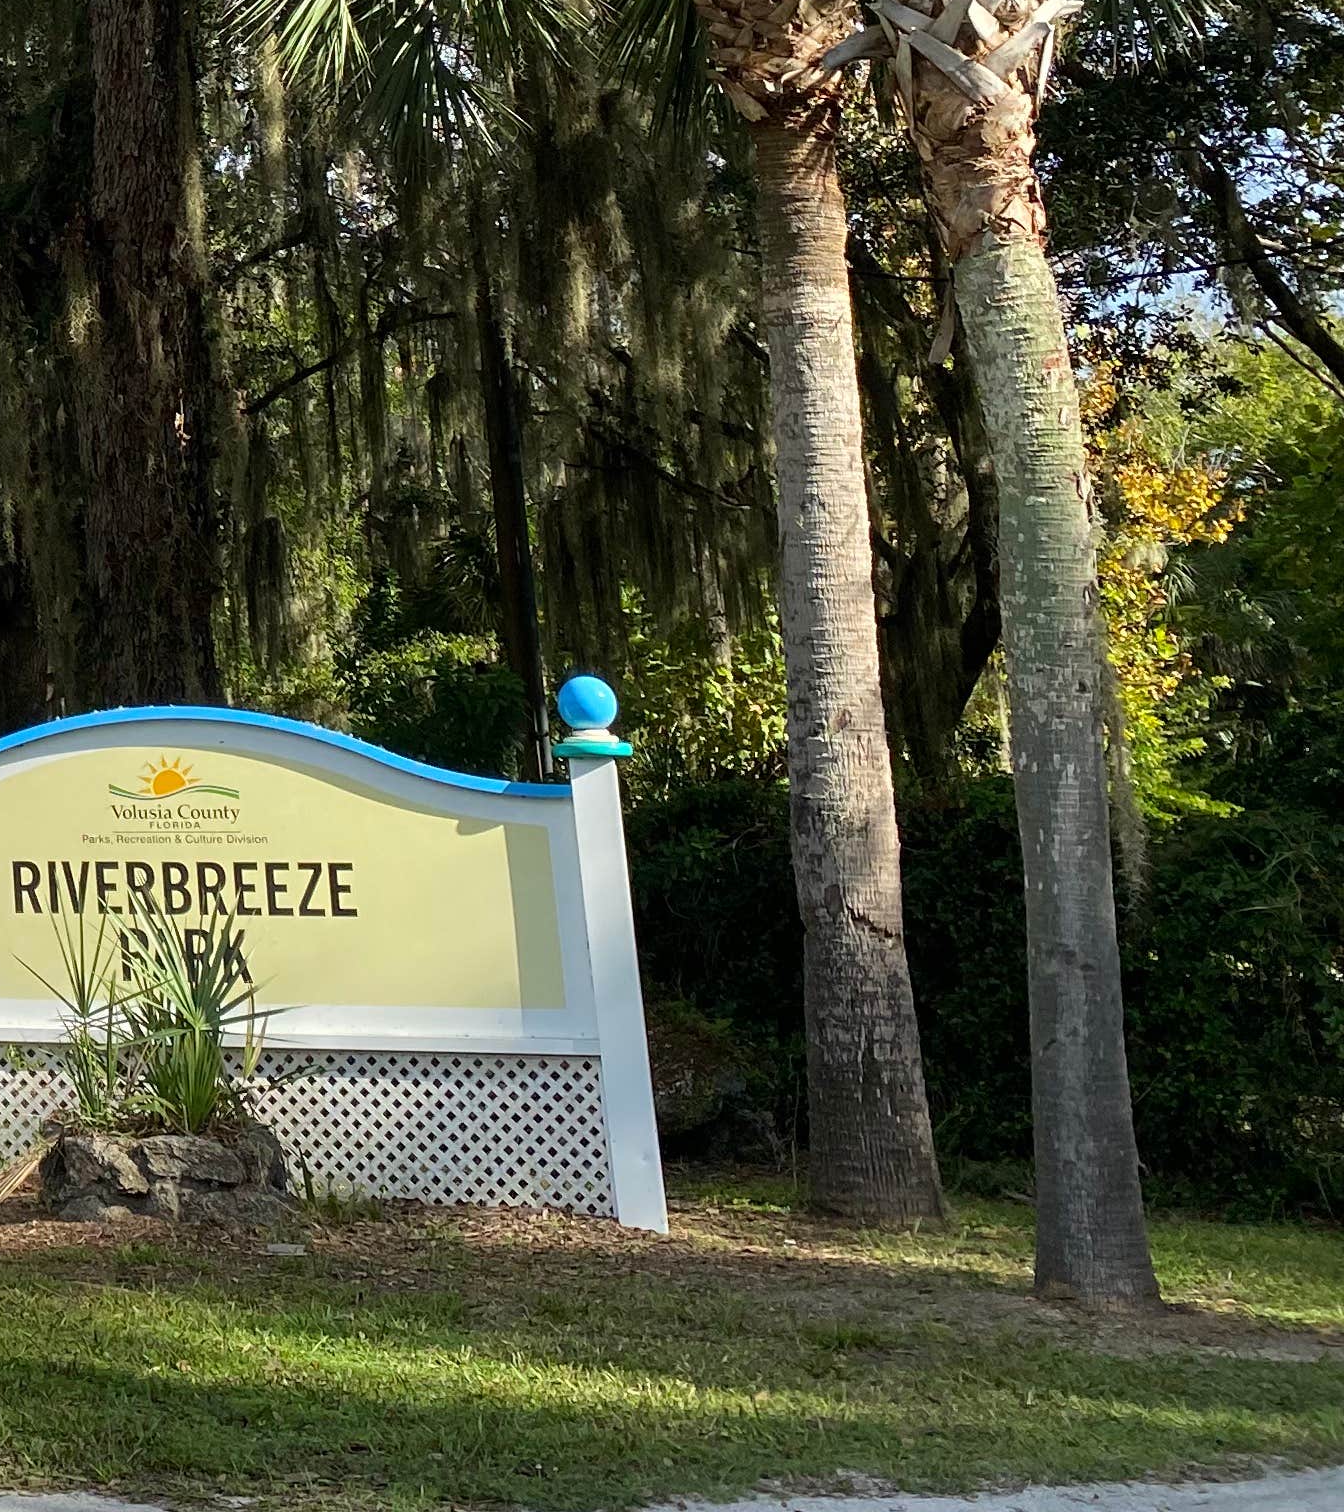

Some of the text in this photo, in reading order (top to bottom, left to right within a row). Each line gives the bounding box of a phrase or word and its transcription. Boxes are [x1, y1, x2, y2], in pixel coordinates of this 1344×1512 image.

[111, 804, 241, 824] Volusia County
[149, 821, 201, 830] FLORIDA
[82, 834, 269, 845] Parks, Recreation & Culture Division
[12, 860, 358, 917] RIVERBREEZE
